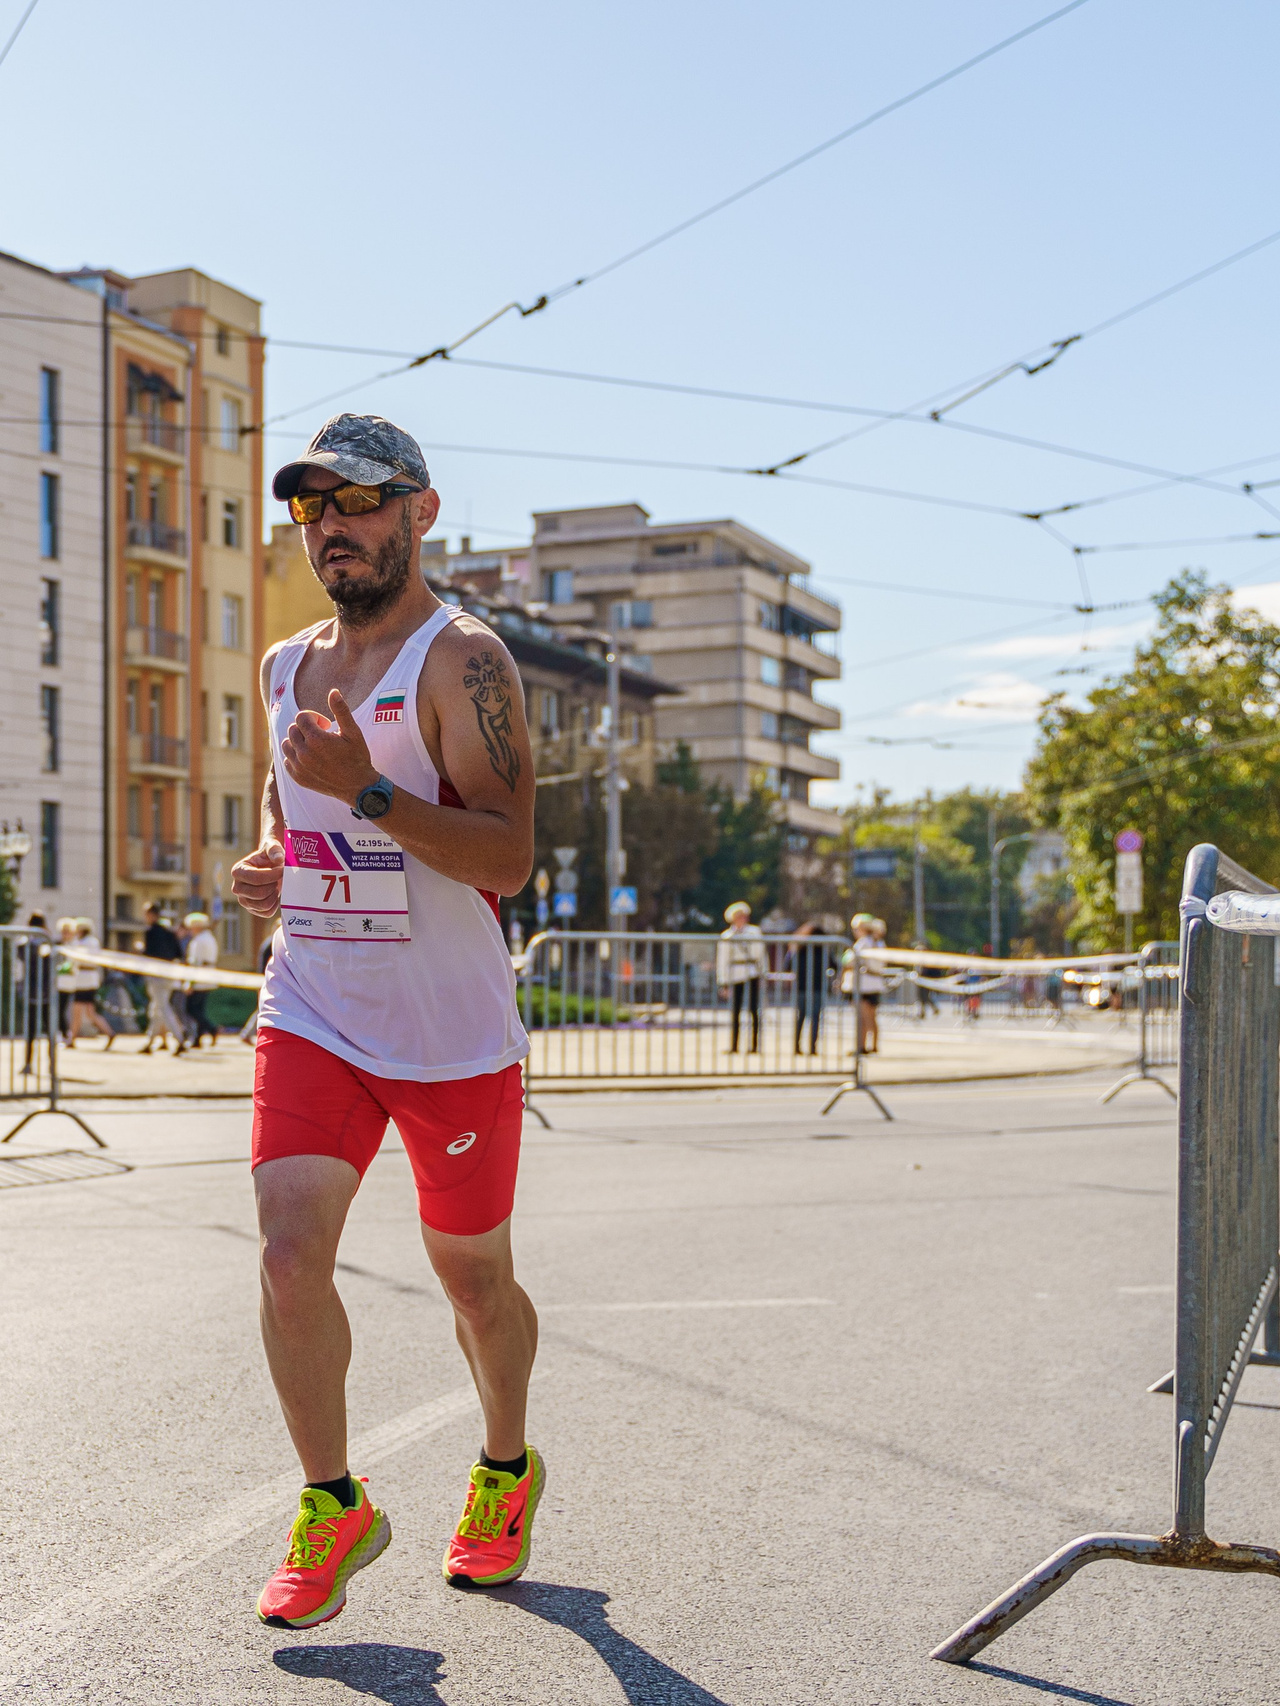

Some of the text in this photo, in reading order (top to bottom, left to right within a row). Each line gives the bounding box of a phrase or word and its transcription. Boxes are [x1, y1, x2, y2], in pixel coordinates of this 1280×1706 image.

[374, 711, 401, 722] BUL
[356, 839, 382, 847] 42.195
[321, 874, 351, 903] 71
